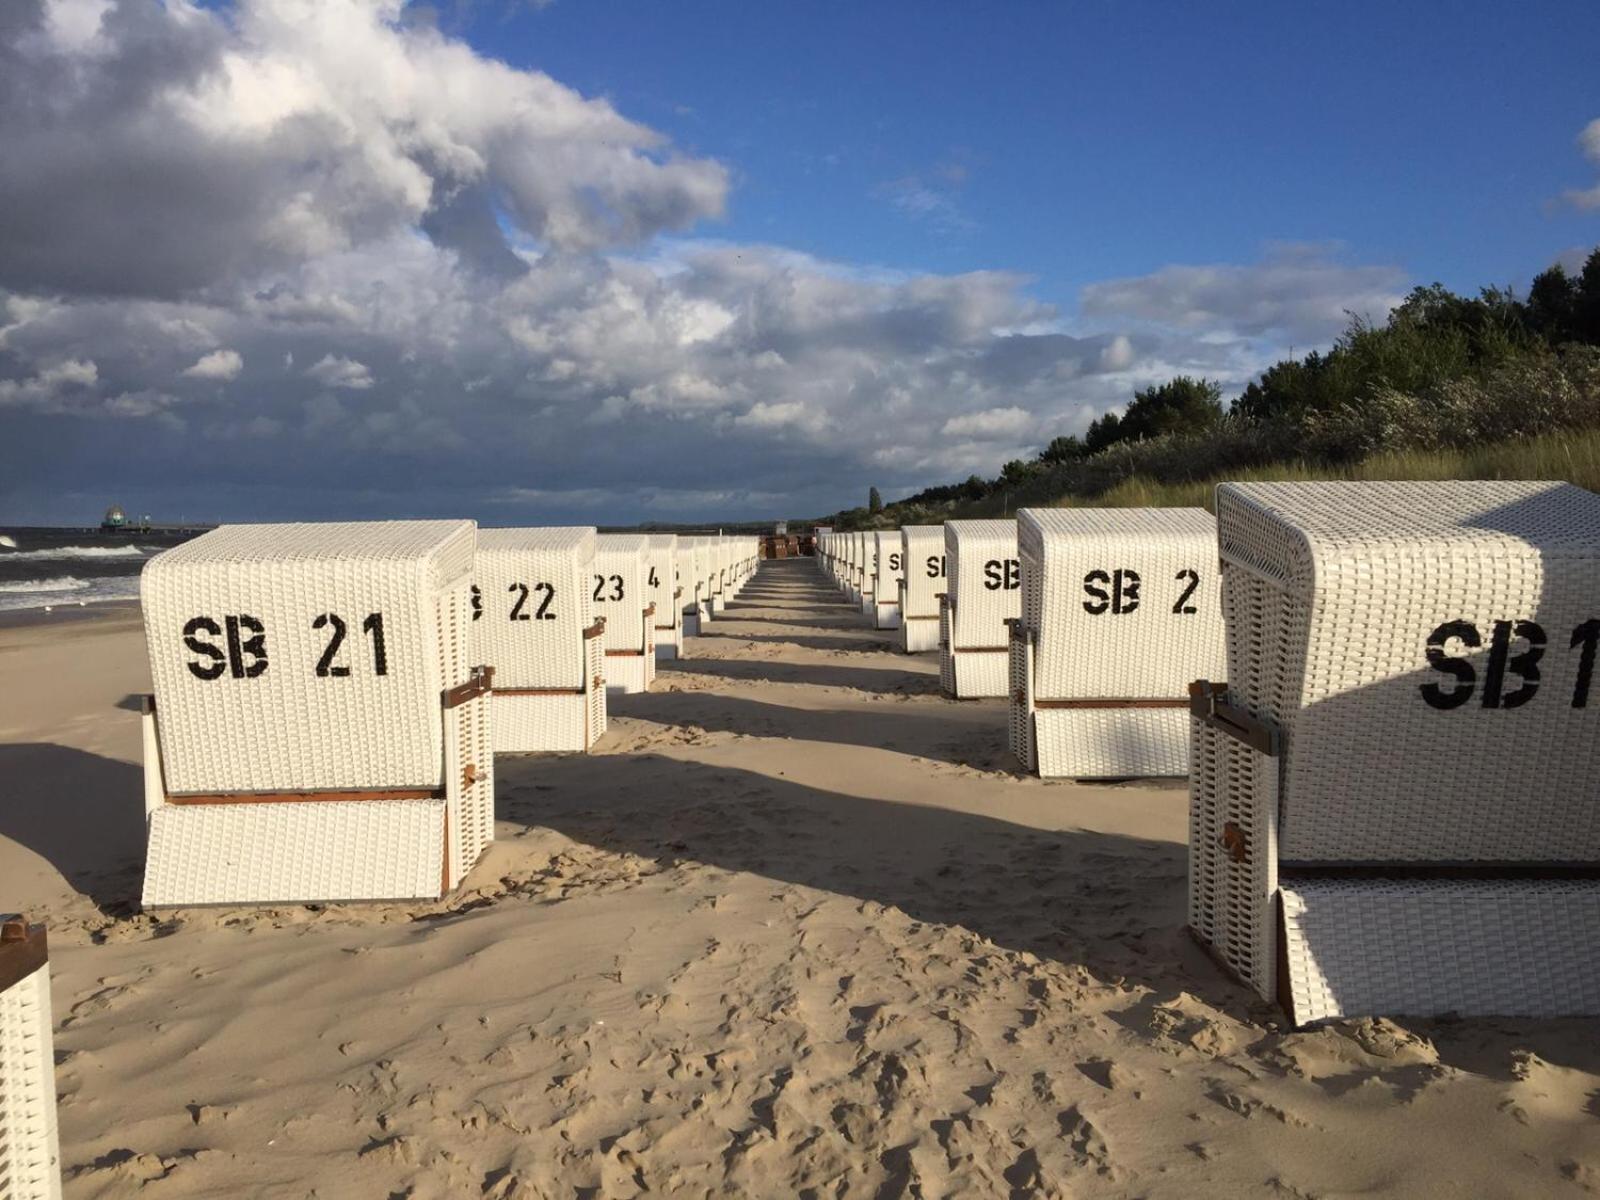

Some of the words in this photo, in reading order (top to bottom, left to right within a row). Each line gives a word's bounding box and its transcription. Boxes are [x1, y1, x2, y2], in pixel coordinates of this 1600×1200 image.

[593, 574, 624, 602] 23
[984, 559, 1020, 590] SB
[1083, 569, 1140, 615] SB
[1172, 569, 1200, 614] 2
[508, 583, 557, 621] 22
[183, 614, 269, 681] SB
[312, 613, 387, 677] 21
[1419, 619, 1548, 710] SB
[1570, 618, 1600, 708] 1
